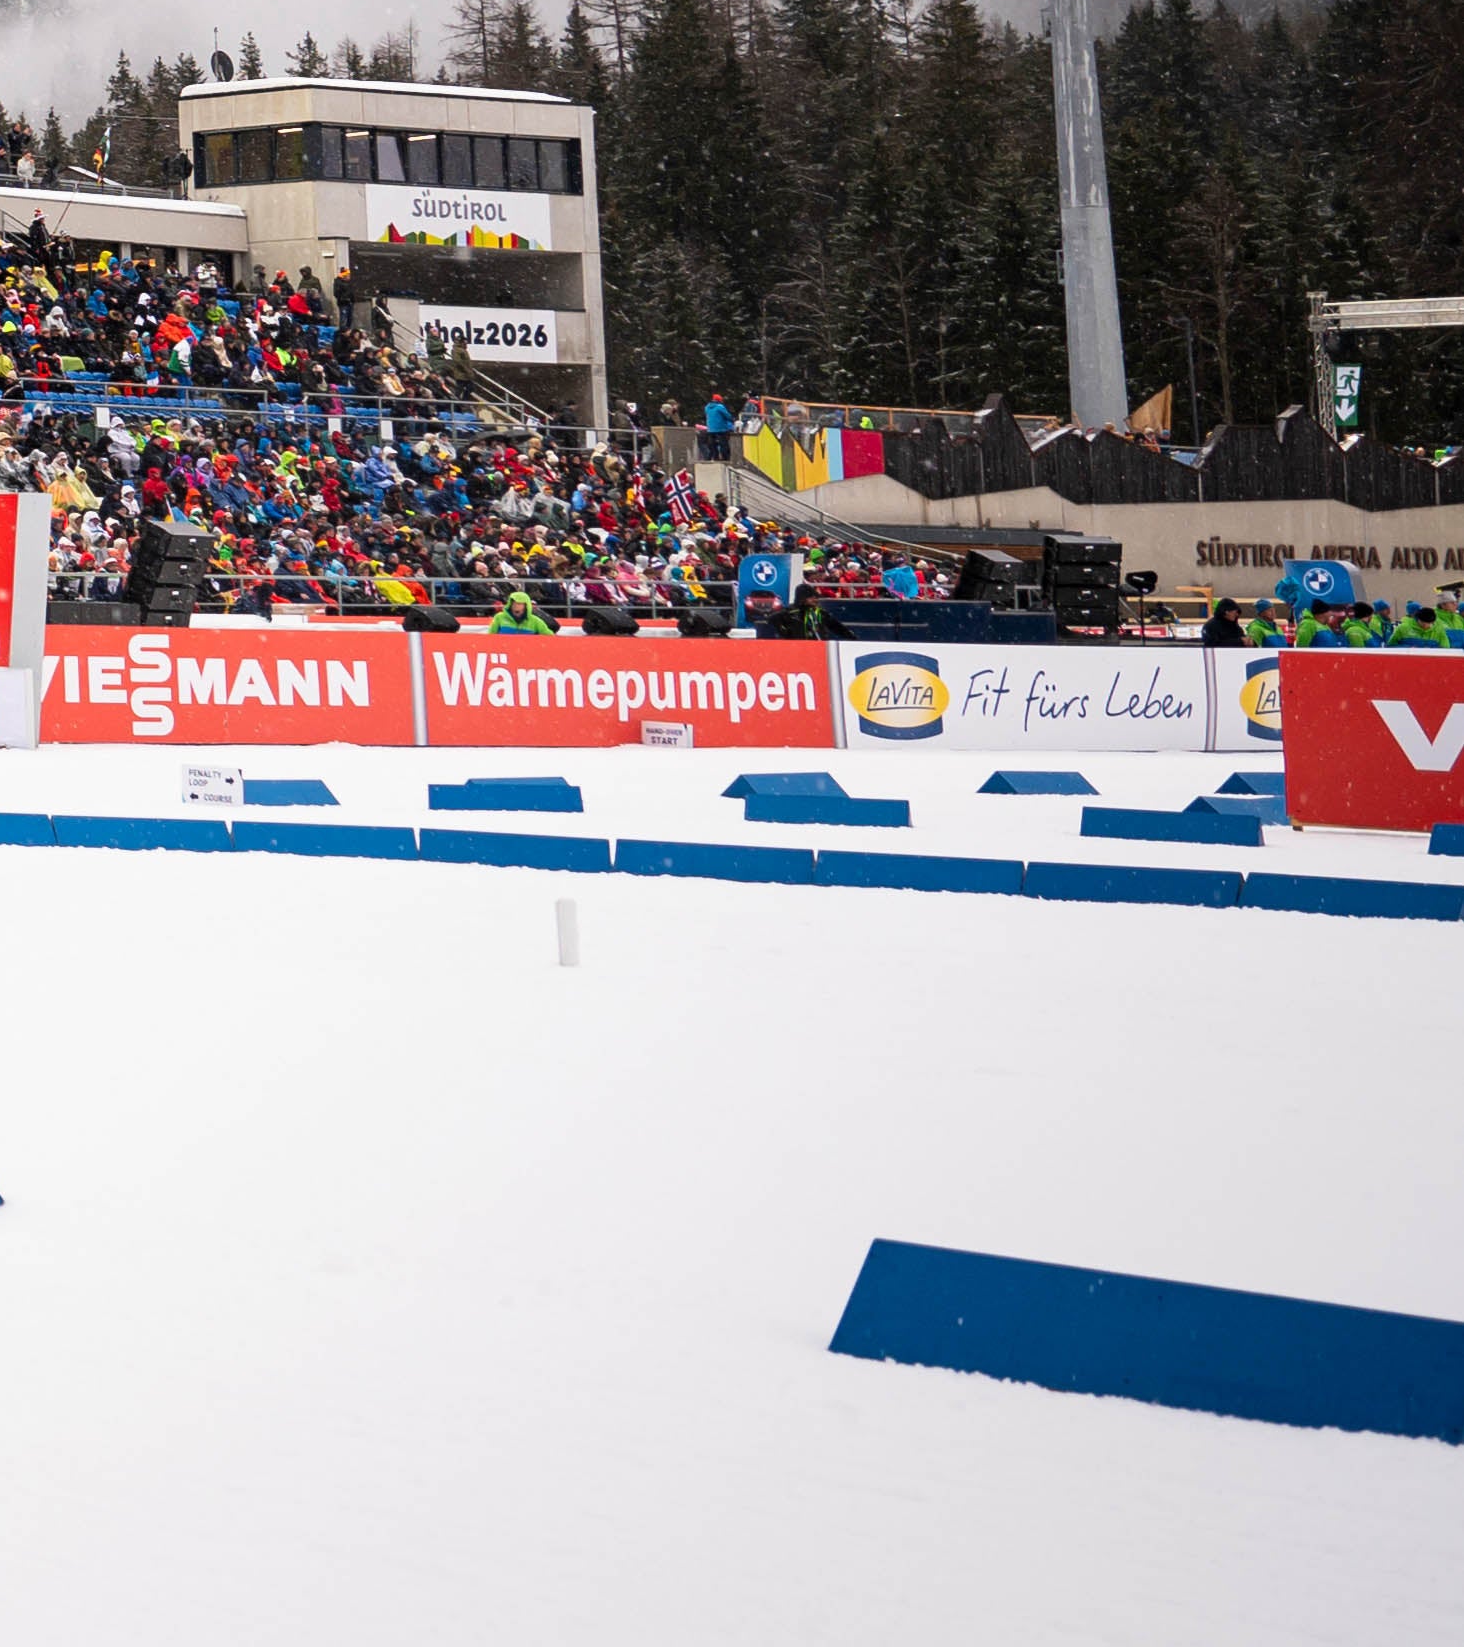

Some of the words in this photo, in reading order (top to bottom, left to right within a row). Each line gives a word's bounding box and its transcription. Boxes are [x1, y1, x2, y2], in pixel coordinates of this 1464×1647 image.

[1390, 546, 1439, 570] ALTO
[432, 651, 816, 723] Wärmepumpen
[960, 667, 1011, 718] Fit
[1022, 670, 1090, 733] fürs
[1104, 665, 1194, 720] Leben
[188, 768, 222, 779] PENALTY
